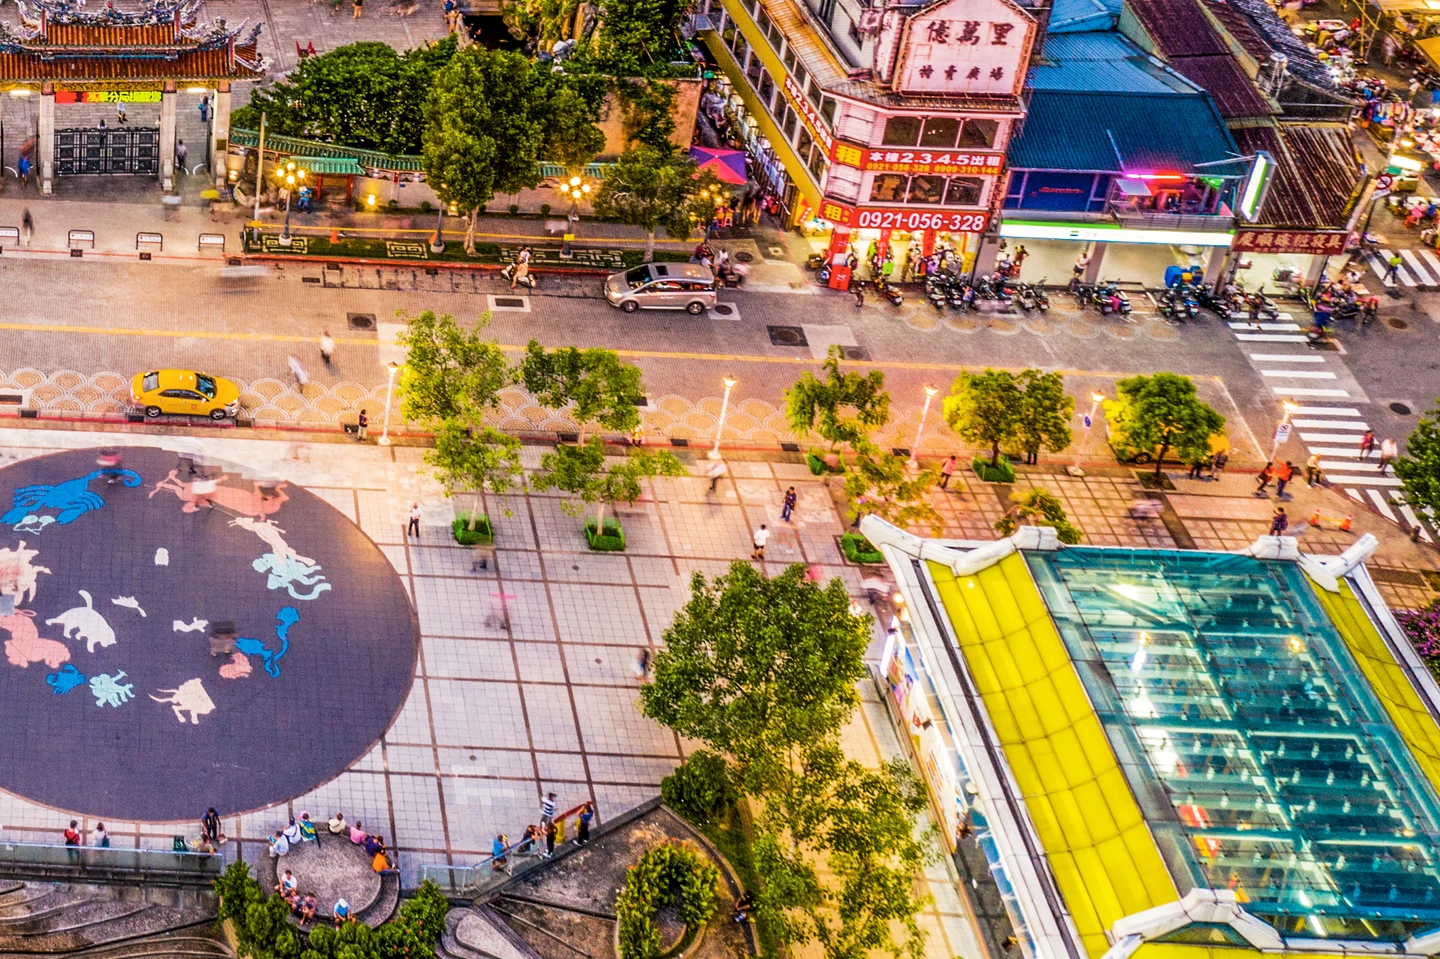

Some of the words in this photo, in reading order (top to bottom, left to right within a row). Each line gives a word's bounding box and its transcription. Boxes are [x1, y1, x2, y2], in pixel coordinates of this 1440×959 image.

[926, 21, 1015, 47] 億萬里
[918, 64, 1005, 81] 特賣廣場
[835, 143, 862, 167] 租
[869, 151, 1000, 167] 本棟2.3.4.5出租
[867, 162, 930, 172] 0921-056-328
[934, 164, 998, 175] 0909-310-144
[824, 203, 843, 222] 租
[859, 211, 985, 232] 0921-056-328
